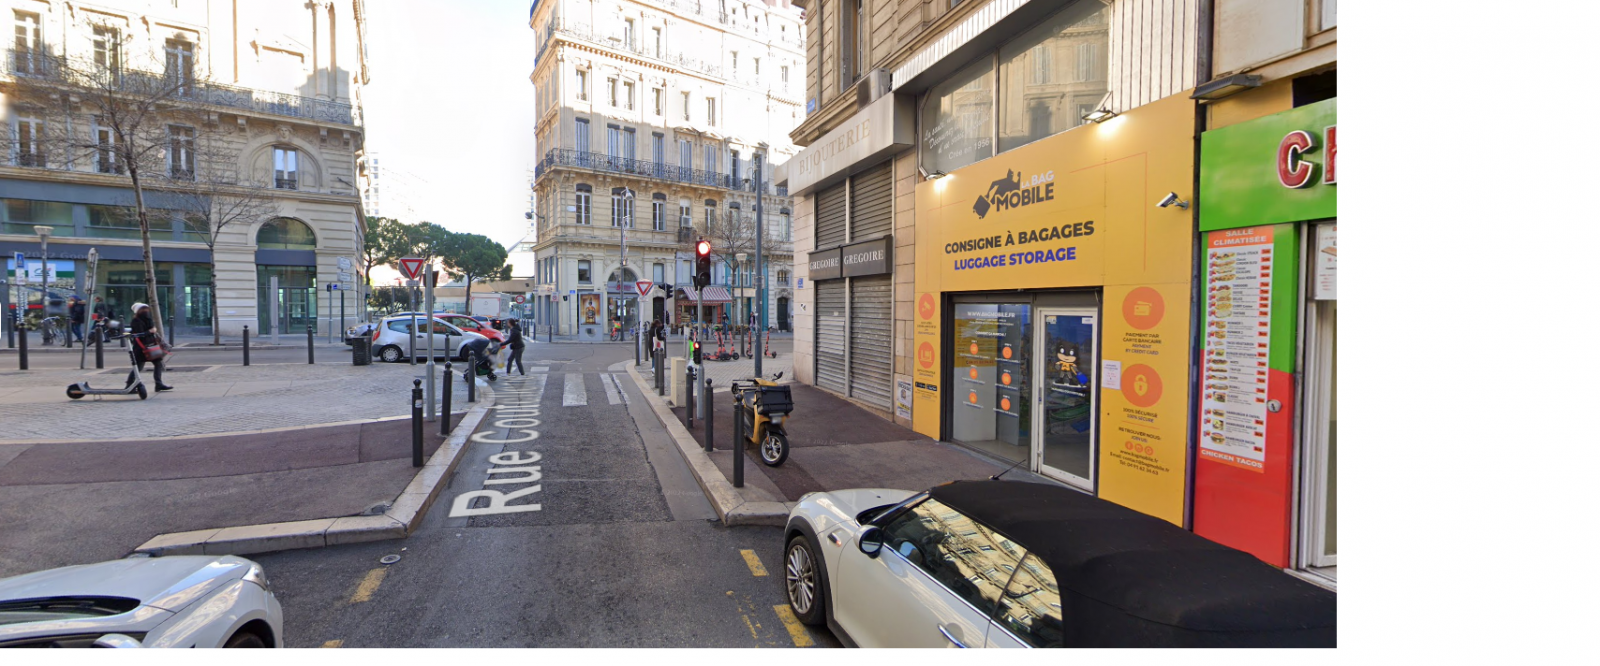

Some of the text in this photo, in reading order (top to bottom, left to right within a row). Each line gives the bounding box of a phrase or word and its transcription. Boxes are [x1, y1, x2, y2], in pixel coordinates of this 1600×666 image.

[799, 118, 871, 175] BIJOUTERIE
[974, 137, 990, 151] 1956
[1021, 170, 1055, 189] LA BAG
[995, 182, 1055, 213] MOBILE
[945, 220, 1095, 254] CONSIGNE À BAGAGES
[1213, 235, 1267, 246] CLIMATISÉE
[1226, 228, 1254, 238] SALLE
[809, 250, 884, 270] GREGOIRE GREGOIRE
[954, 246, 1076, 271] LUGGAGE STORAGE
[1201, 449, 1263, 469] CHICKEN TACOS
